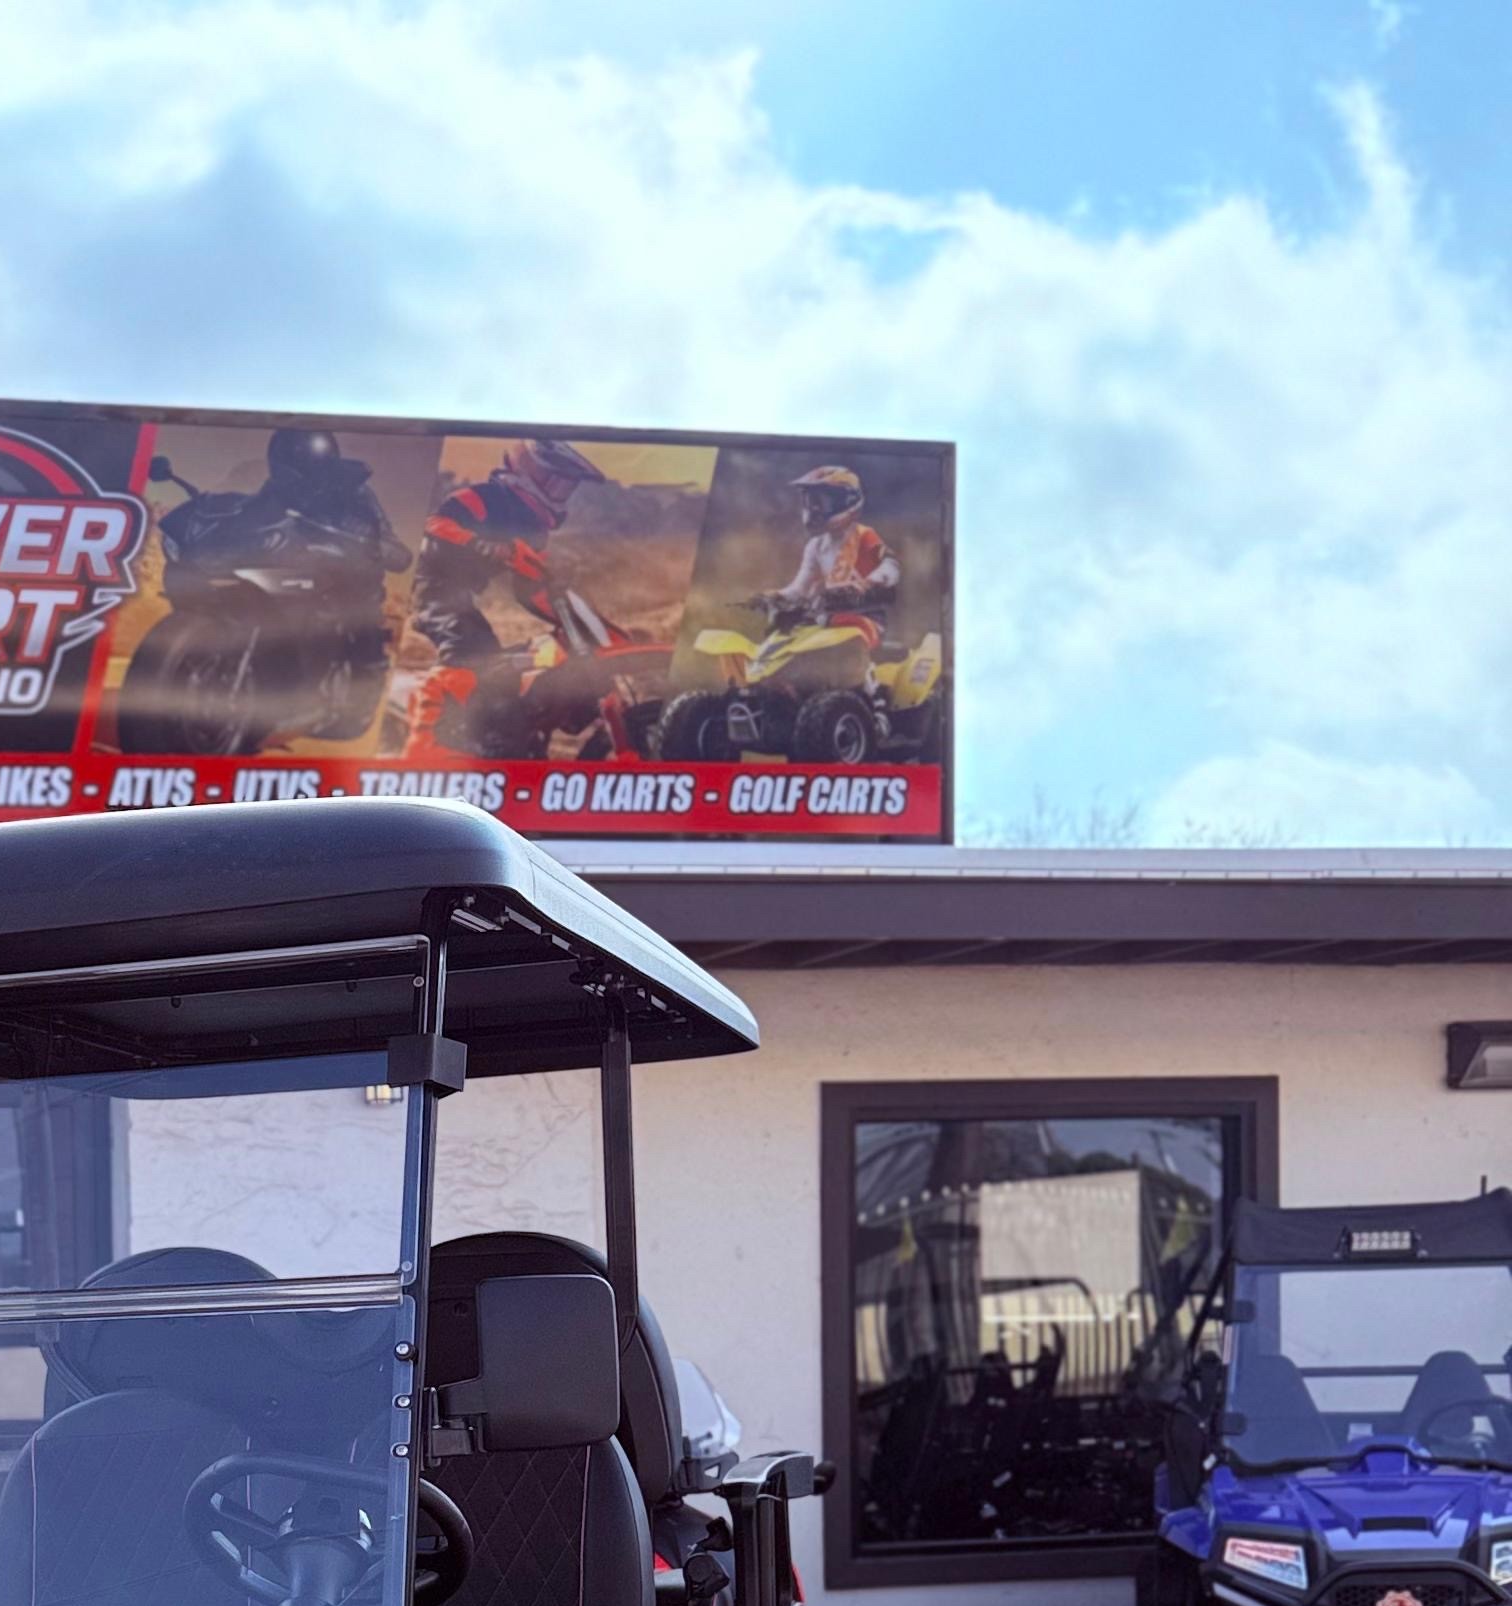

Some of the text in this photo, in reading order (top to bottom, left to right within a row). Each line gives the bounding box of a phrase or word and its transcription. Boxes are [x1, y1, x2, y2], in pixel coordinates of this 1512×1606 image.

[109, 767, 197, 808] ATVS
[234, 769, 319, 802] UTVS
[359, 772, 506, 811] TRAILERS
[541, 772, 588, 813] GO
[591, 773, 695, 814] KARTS
[729, 775, 806, 815] GOLF
[807, 776, 909, 815] CARTS
